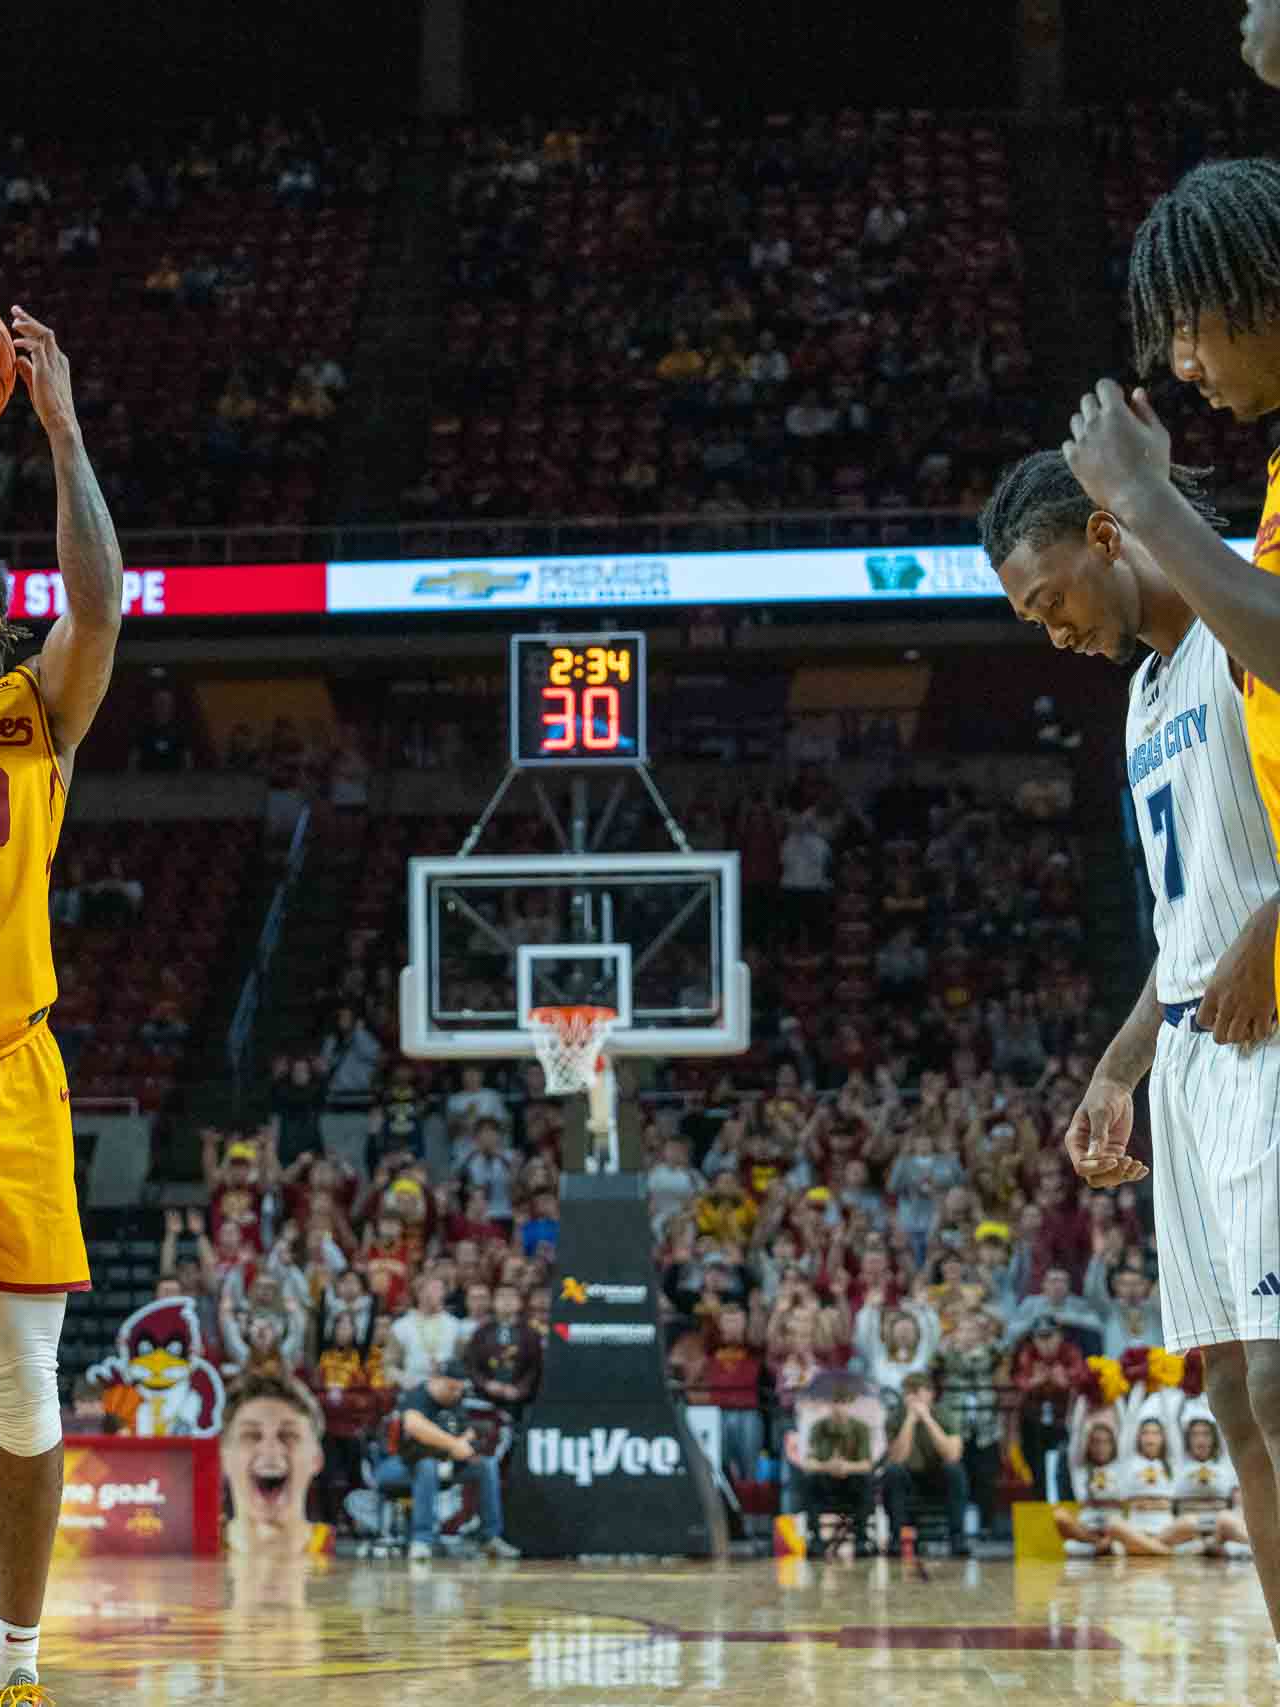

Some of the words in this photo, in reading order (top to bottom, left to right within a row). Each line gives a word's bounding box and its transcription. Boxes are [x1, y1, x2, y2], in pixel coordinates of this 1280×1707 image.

[25, 571, 165, 615] STPE
[549, 648, 630, 685] 2:34
[542, 687, 619, 750] 30
[1164, 703, 1207, 759] CITY
[1145, 782, 1185, 902] 7
[527, 1428, 681, 1487] HyVee
